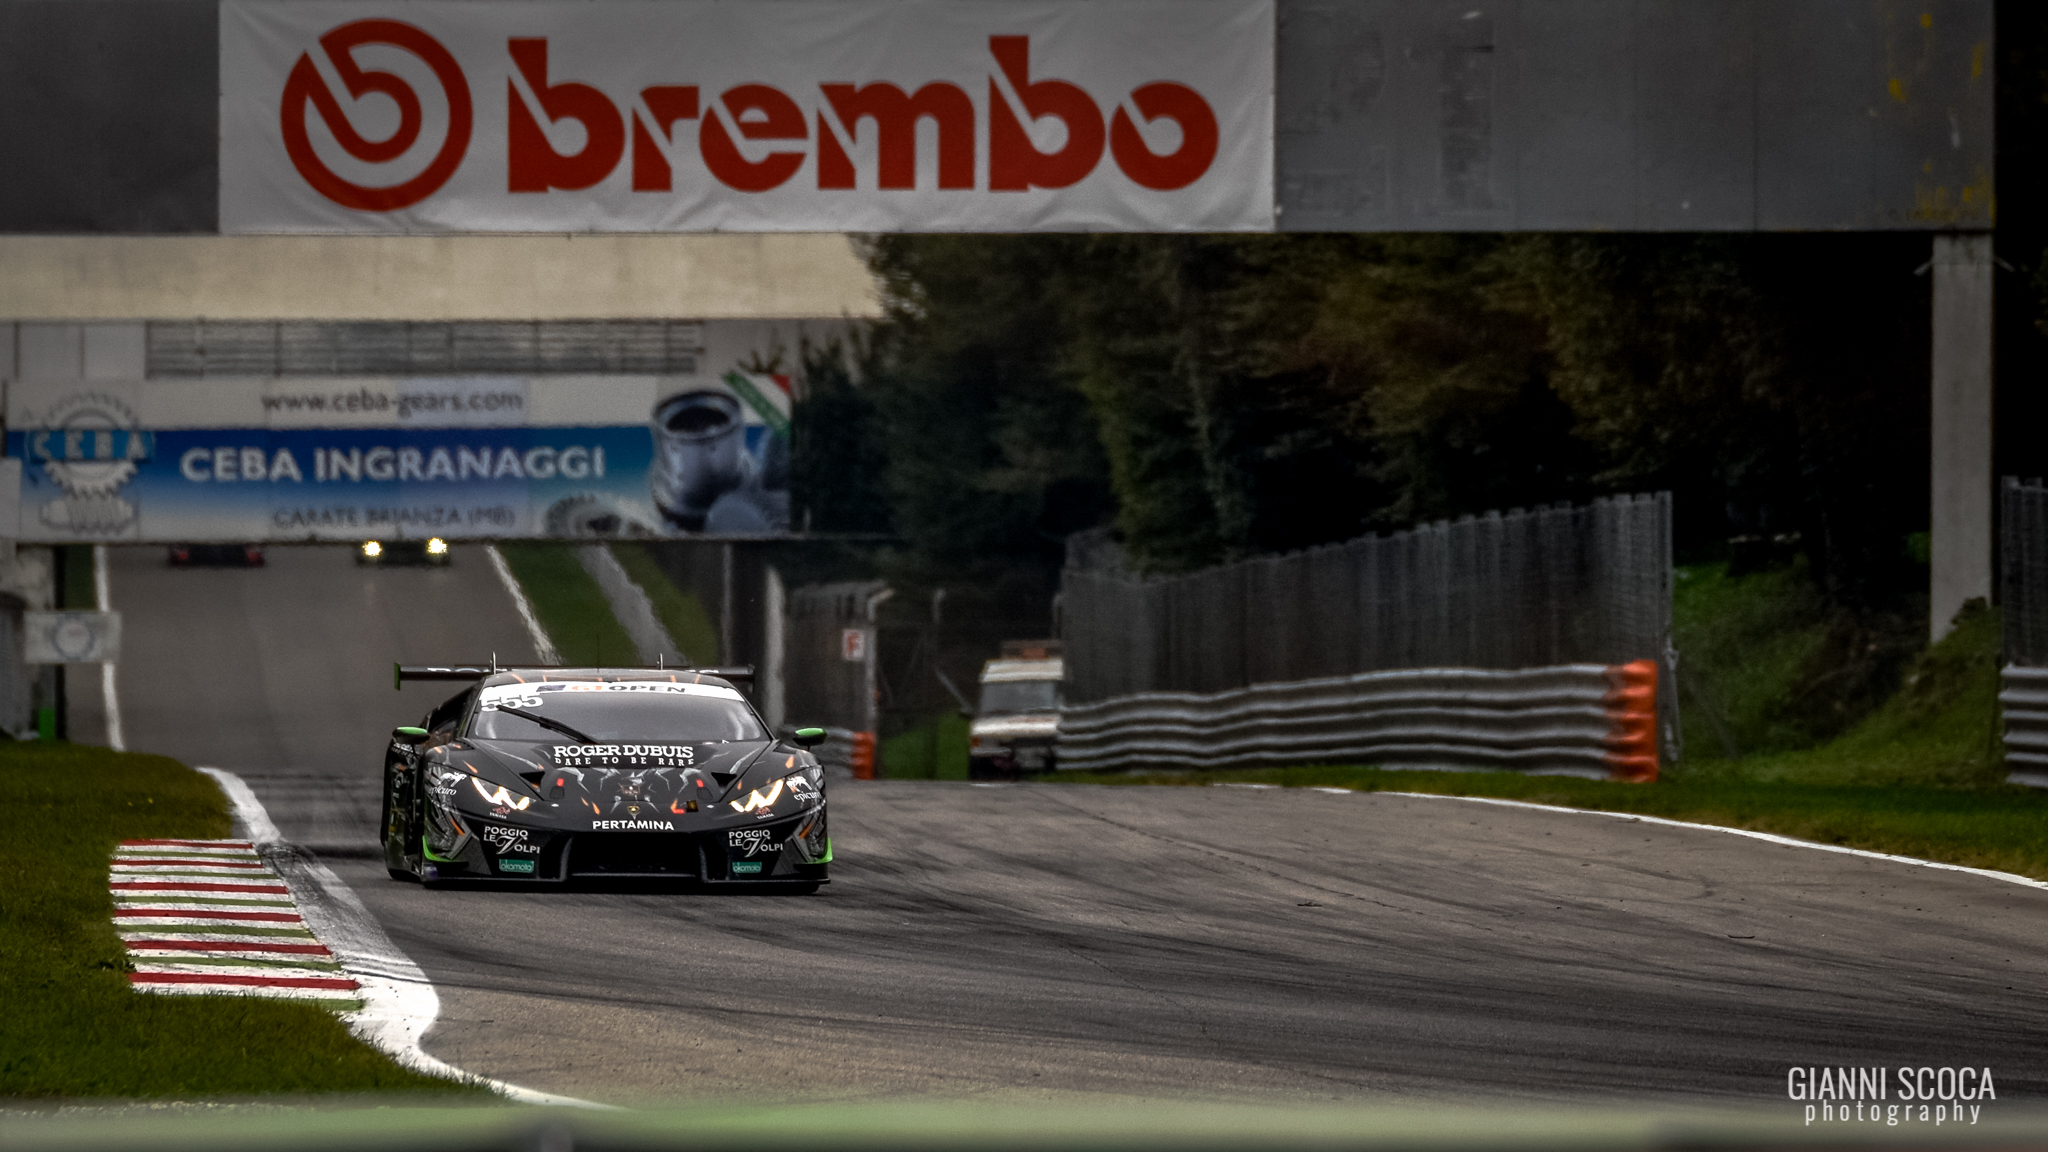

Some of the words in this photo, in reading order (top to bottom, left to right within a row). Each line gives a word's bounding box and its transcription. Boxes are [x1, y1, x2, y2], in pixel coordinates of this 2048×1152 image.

[508, 35, 1219, 193] brembo
[261, 386, 525, 418] www.ceba-gears.com
[179, 445, 303, 482] CEBA
[313, 444, 606, 481] INGRANAGGI
[273, 507, 358, 528] CARATE
[366, 506, 461, 526] BRIANZA
[481, 694, 544, 712] 555
[553, 744, 621, 758] ROGER
[623, 744, 694, 758] DUBUIS
[555, 757, 591, 766] DARE
[631, 756, 647, 764] BE
[658, 757, 694, 767] RARE
[484, 826, 529, 838] POGGIO
[592, 820, 675, 831] PERTAMINA
[728, 830, 771, 839] POGGIO
[484, 834, 496, 842] LE
[495, 836, 540, 855] VOLPI
[729, 839, 742, 847] LE
[742, 838, 784, 858] VOLPI
